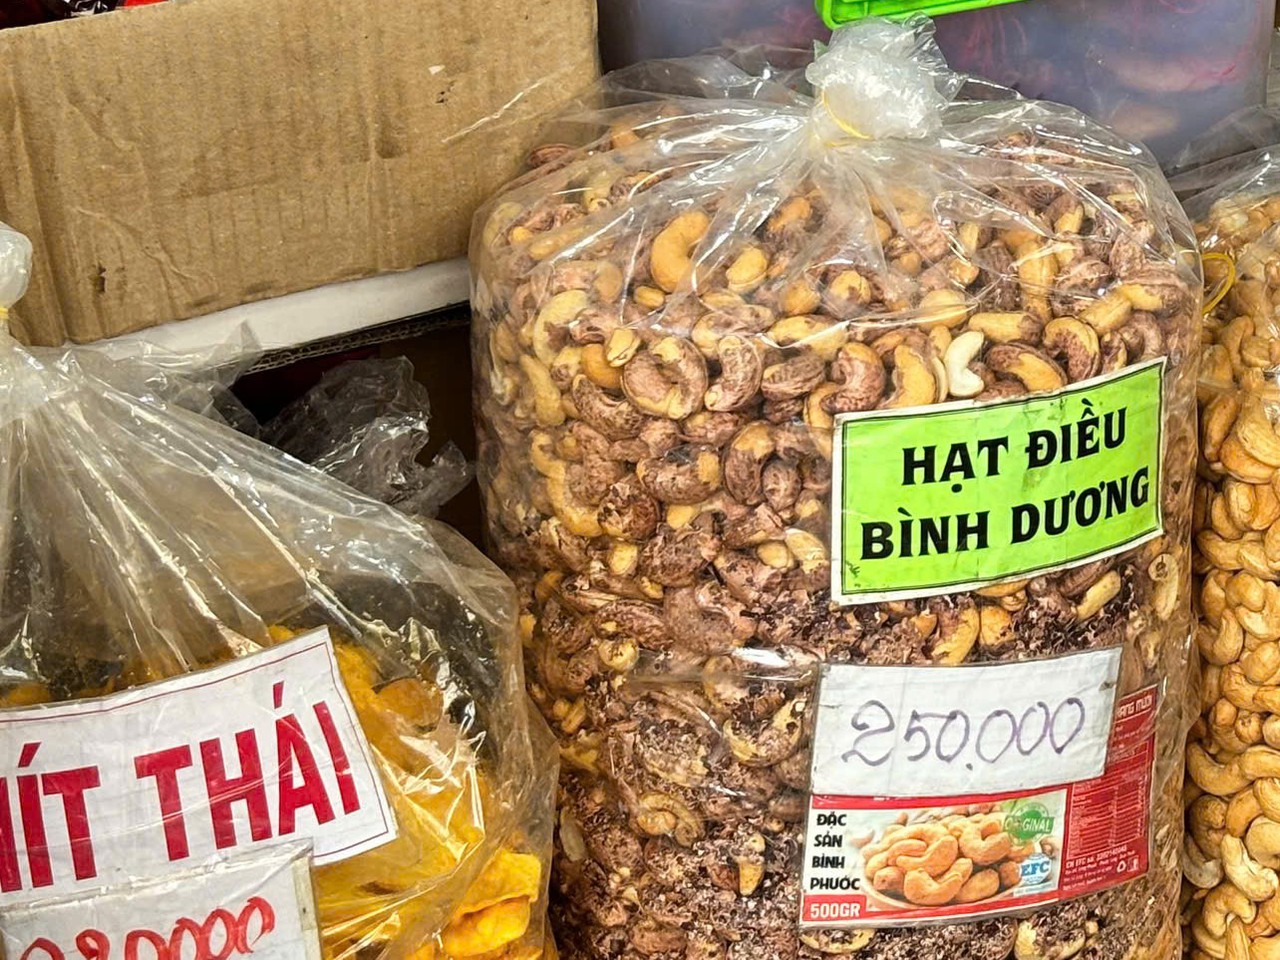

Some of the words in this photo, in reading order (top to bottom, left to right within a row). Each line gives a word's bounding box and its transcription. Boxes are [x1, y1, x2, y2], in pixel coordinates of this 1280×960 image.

[901, 435, 1009, 493] HẠT
[1025, 398, 1127, 470] ĐIỀU
[860, 507, 990, 560] BÌNH
[1011, 466, 1150, 545] DƯƠNG
[841, 698, 1086, 771] 250.000
[134, 680, 361, 862] THÁI
[816, 811, 847, 830] ĐẶC
[1004, 817, 1052, 833] OGINAL
[1020, 860, 1051, 877] EFC
[810, 902, 861, 919] 500GR
